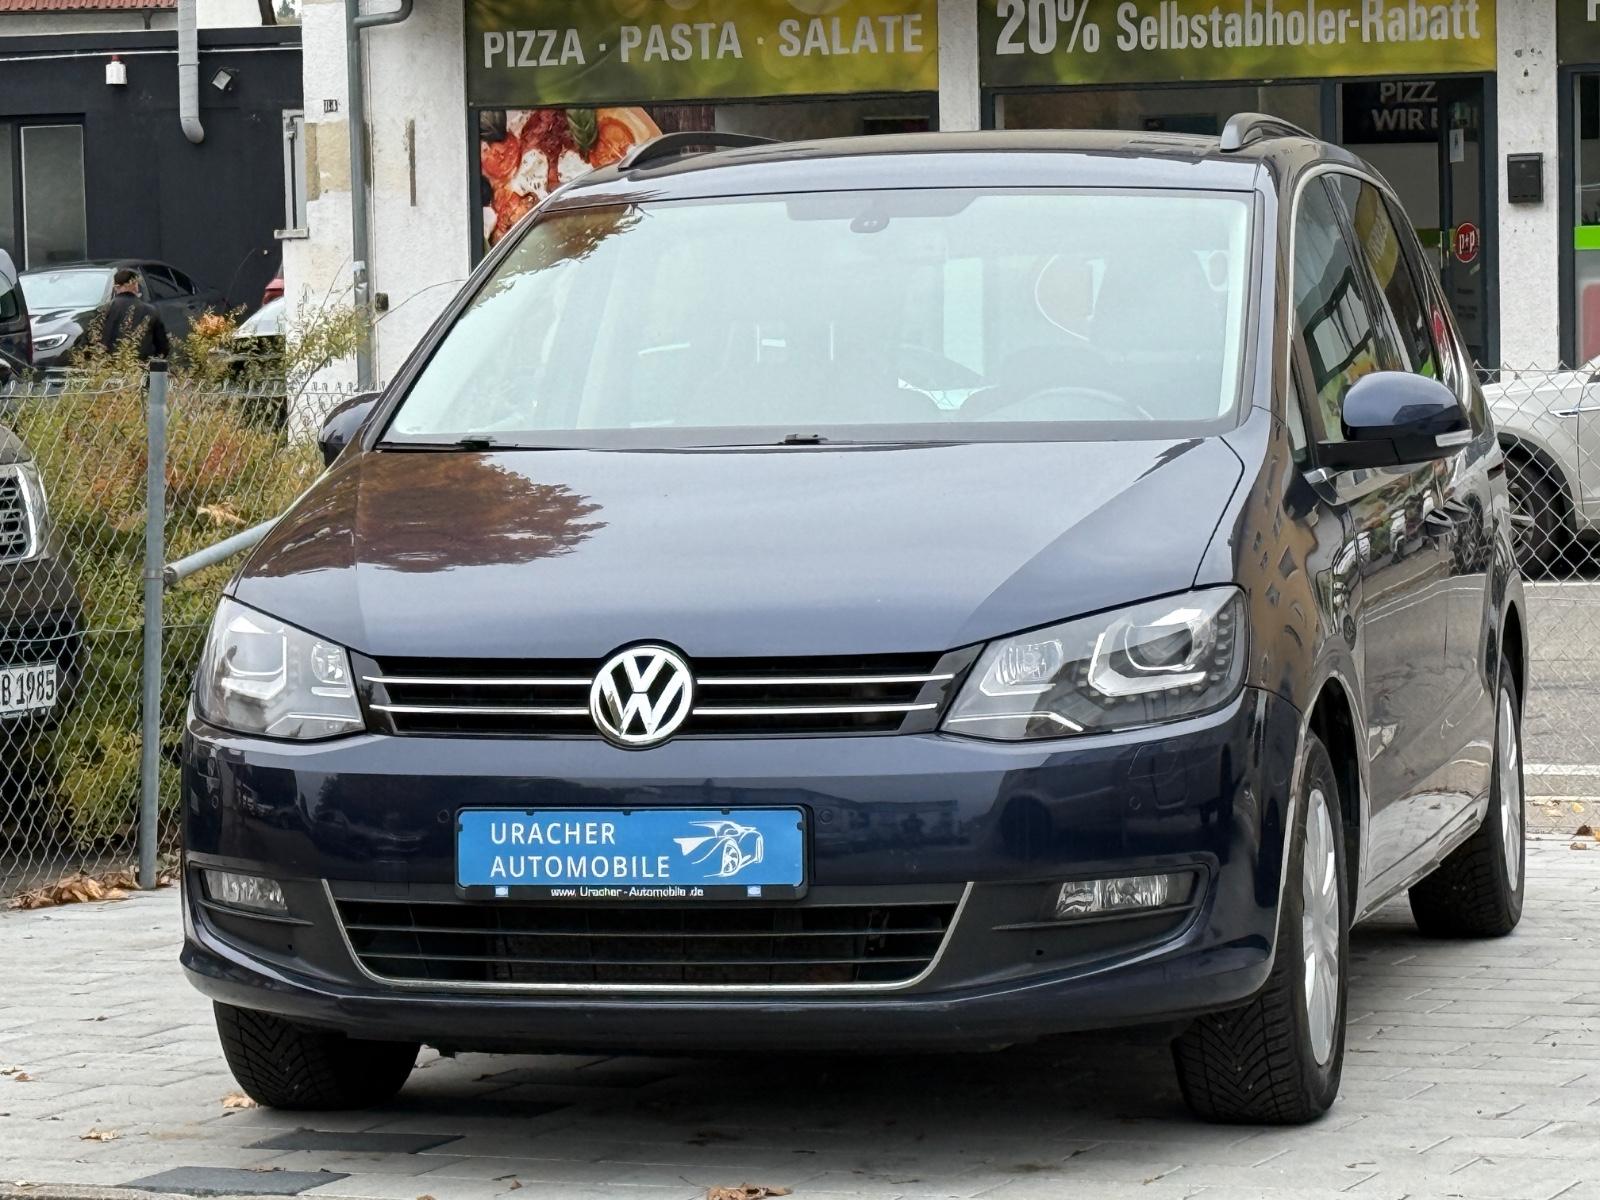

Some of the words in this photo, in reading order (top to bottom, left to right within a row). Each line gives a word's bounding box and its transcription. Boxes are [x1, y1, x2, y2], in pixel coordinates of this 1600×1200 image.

[484, 28, 585, 68] PIZZA
[620, 21, 743, 63] PASTA
[778, 14, 923, 57] SALATE
[996, 0, 1099, 55] 20%
[1117, 0, 1481, 51] Selbstabholer-Rabatt
[1371, 108, 1424, 131] WIR
[16, 669, 54, 705] 1985
[491, 822, 615, 845] URACHER
[490, 855, 670, 878] AUTOMOBILE
